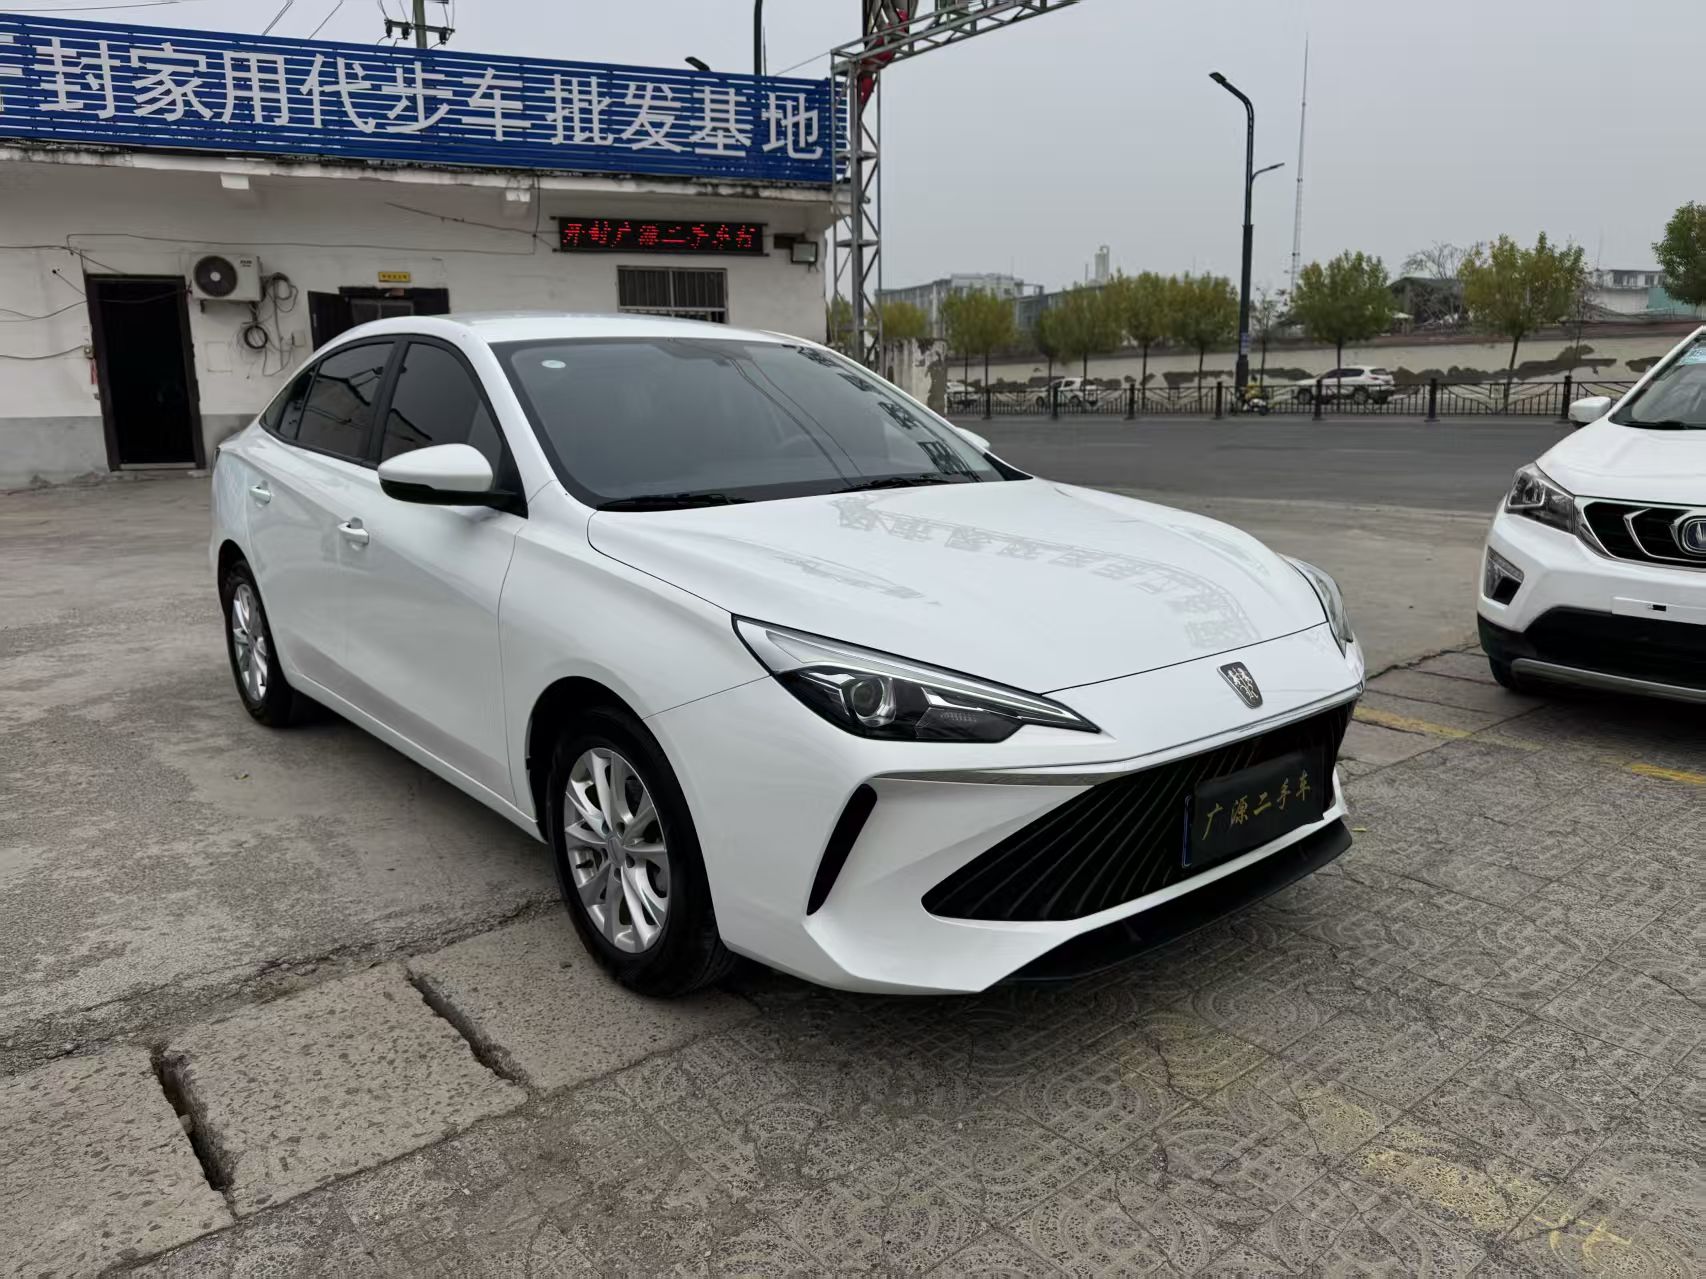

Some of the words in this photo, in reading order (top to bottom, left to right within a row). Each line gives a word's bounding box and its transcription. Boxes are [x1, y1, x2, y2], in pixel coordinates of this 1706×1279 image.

[1202, 770, 1311, 840] 广源二手车
